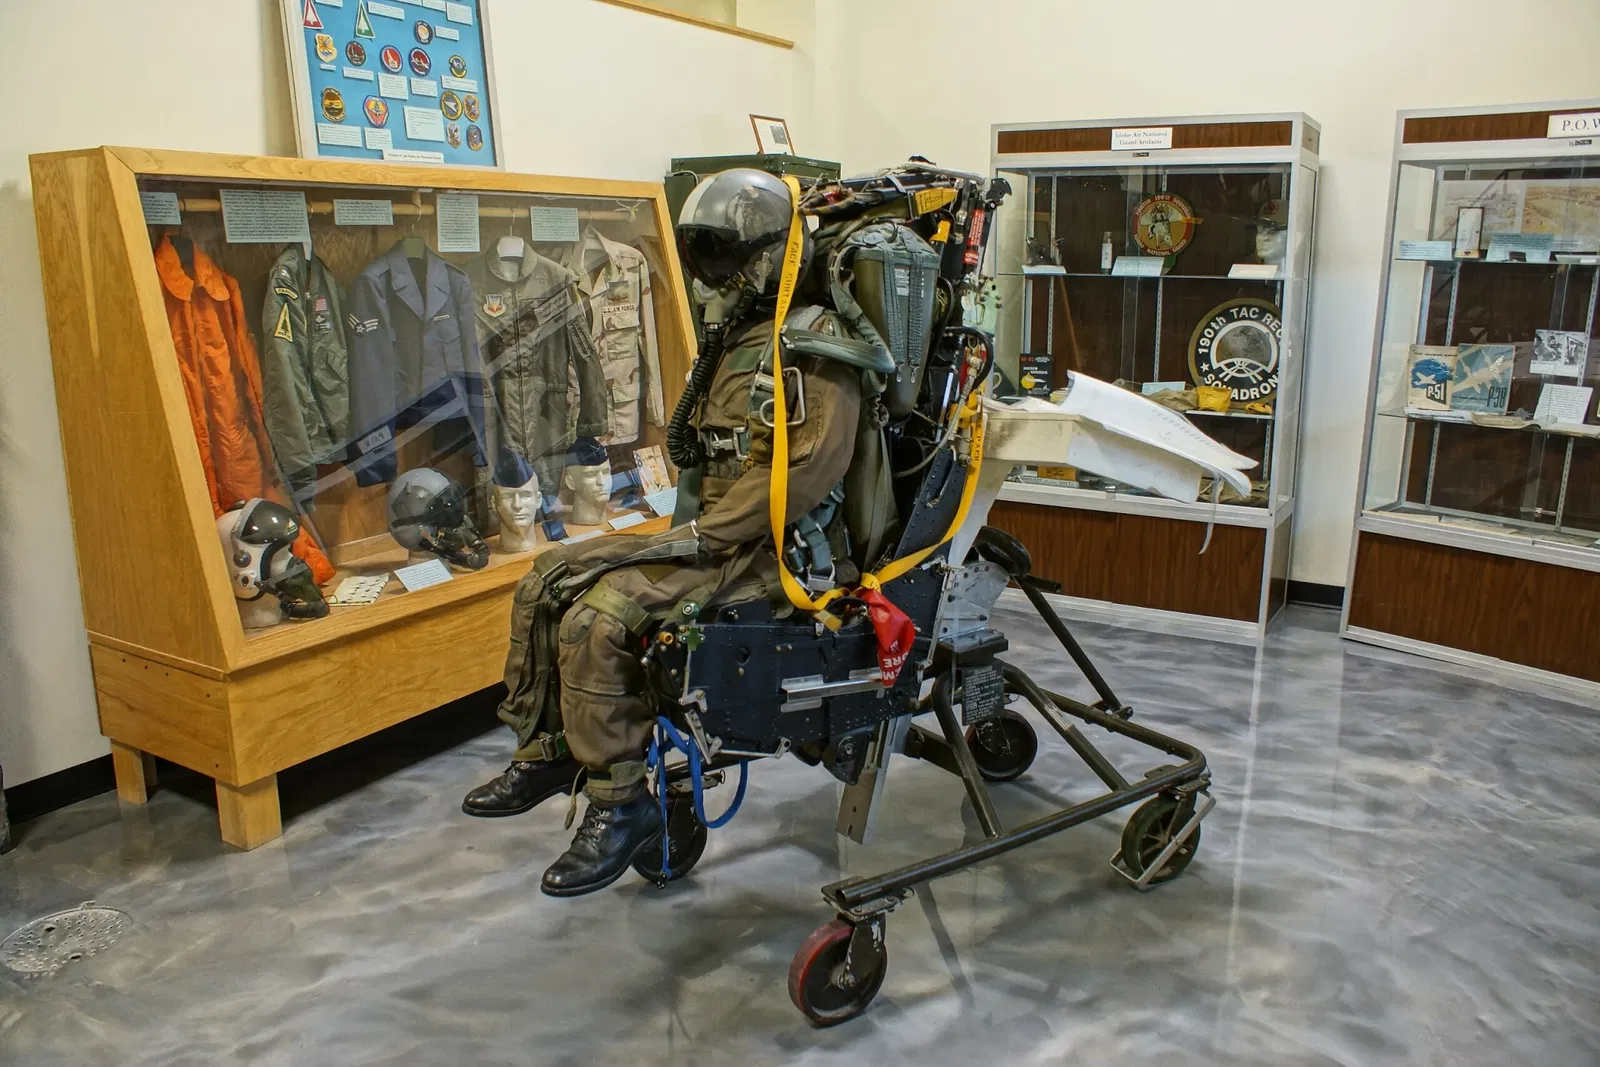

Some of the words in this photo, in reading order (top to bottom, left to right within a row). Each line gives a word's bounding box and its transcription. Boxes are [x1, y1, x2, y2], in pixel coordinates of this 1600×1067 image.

[1197, 315, 1227, 355] 190th
[1229, 307, 1260, 319] TAC
[1261, 312, 1282, 340] REC
[1427, 383, 1445, 400] P-51
